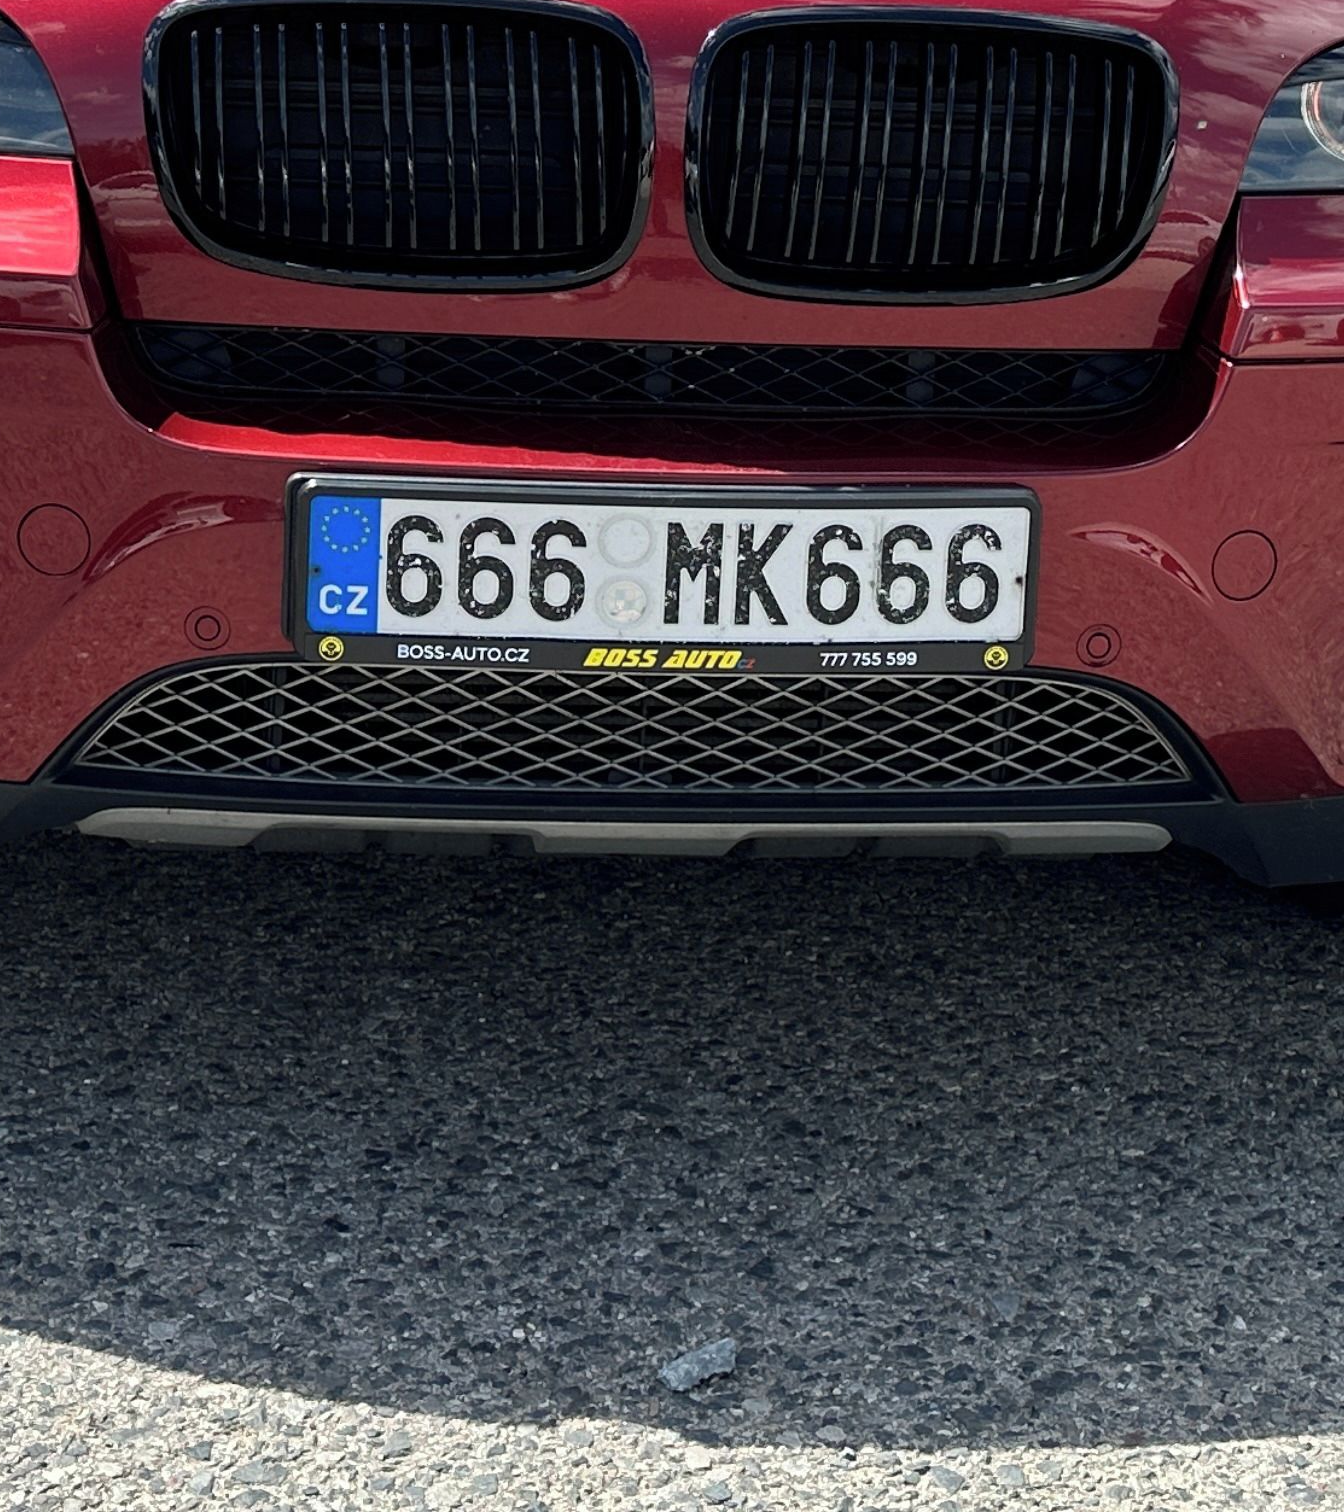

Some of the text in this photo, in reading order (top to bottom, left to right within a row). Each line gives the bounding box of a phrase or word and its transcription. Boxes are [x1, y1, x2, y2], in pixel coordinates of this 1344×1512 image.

[386, 516, 1002, 625] 666 MK666
[318, 584, 369, 616] CZ
[397, 643, 531, 664] BOSS-AUTO.CZ
[583, 648, 659, 668] BOSS
[661, 650, 741, 670] AUTO
[820, 652, 848, 666] 777
[851, 652, 882, 666] 755
[885, 652, 918, 666] 599
